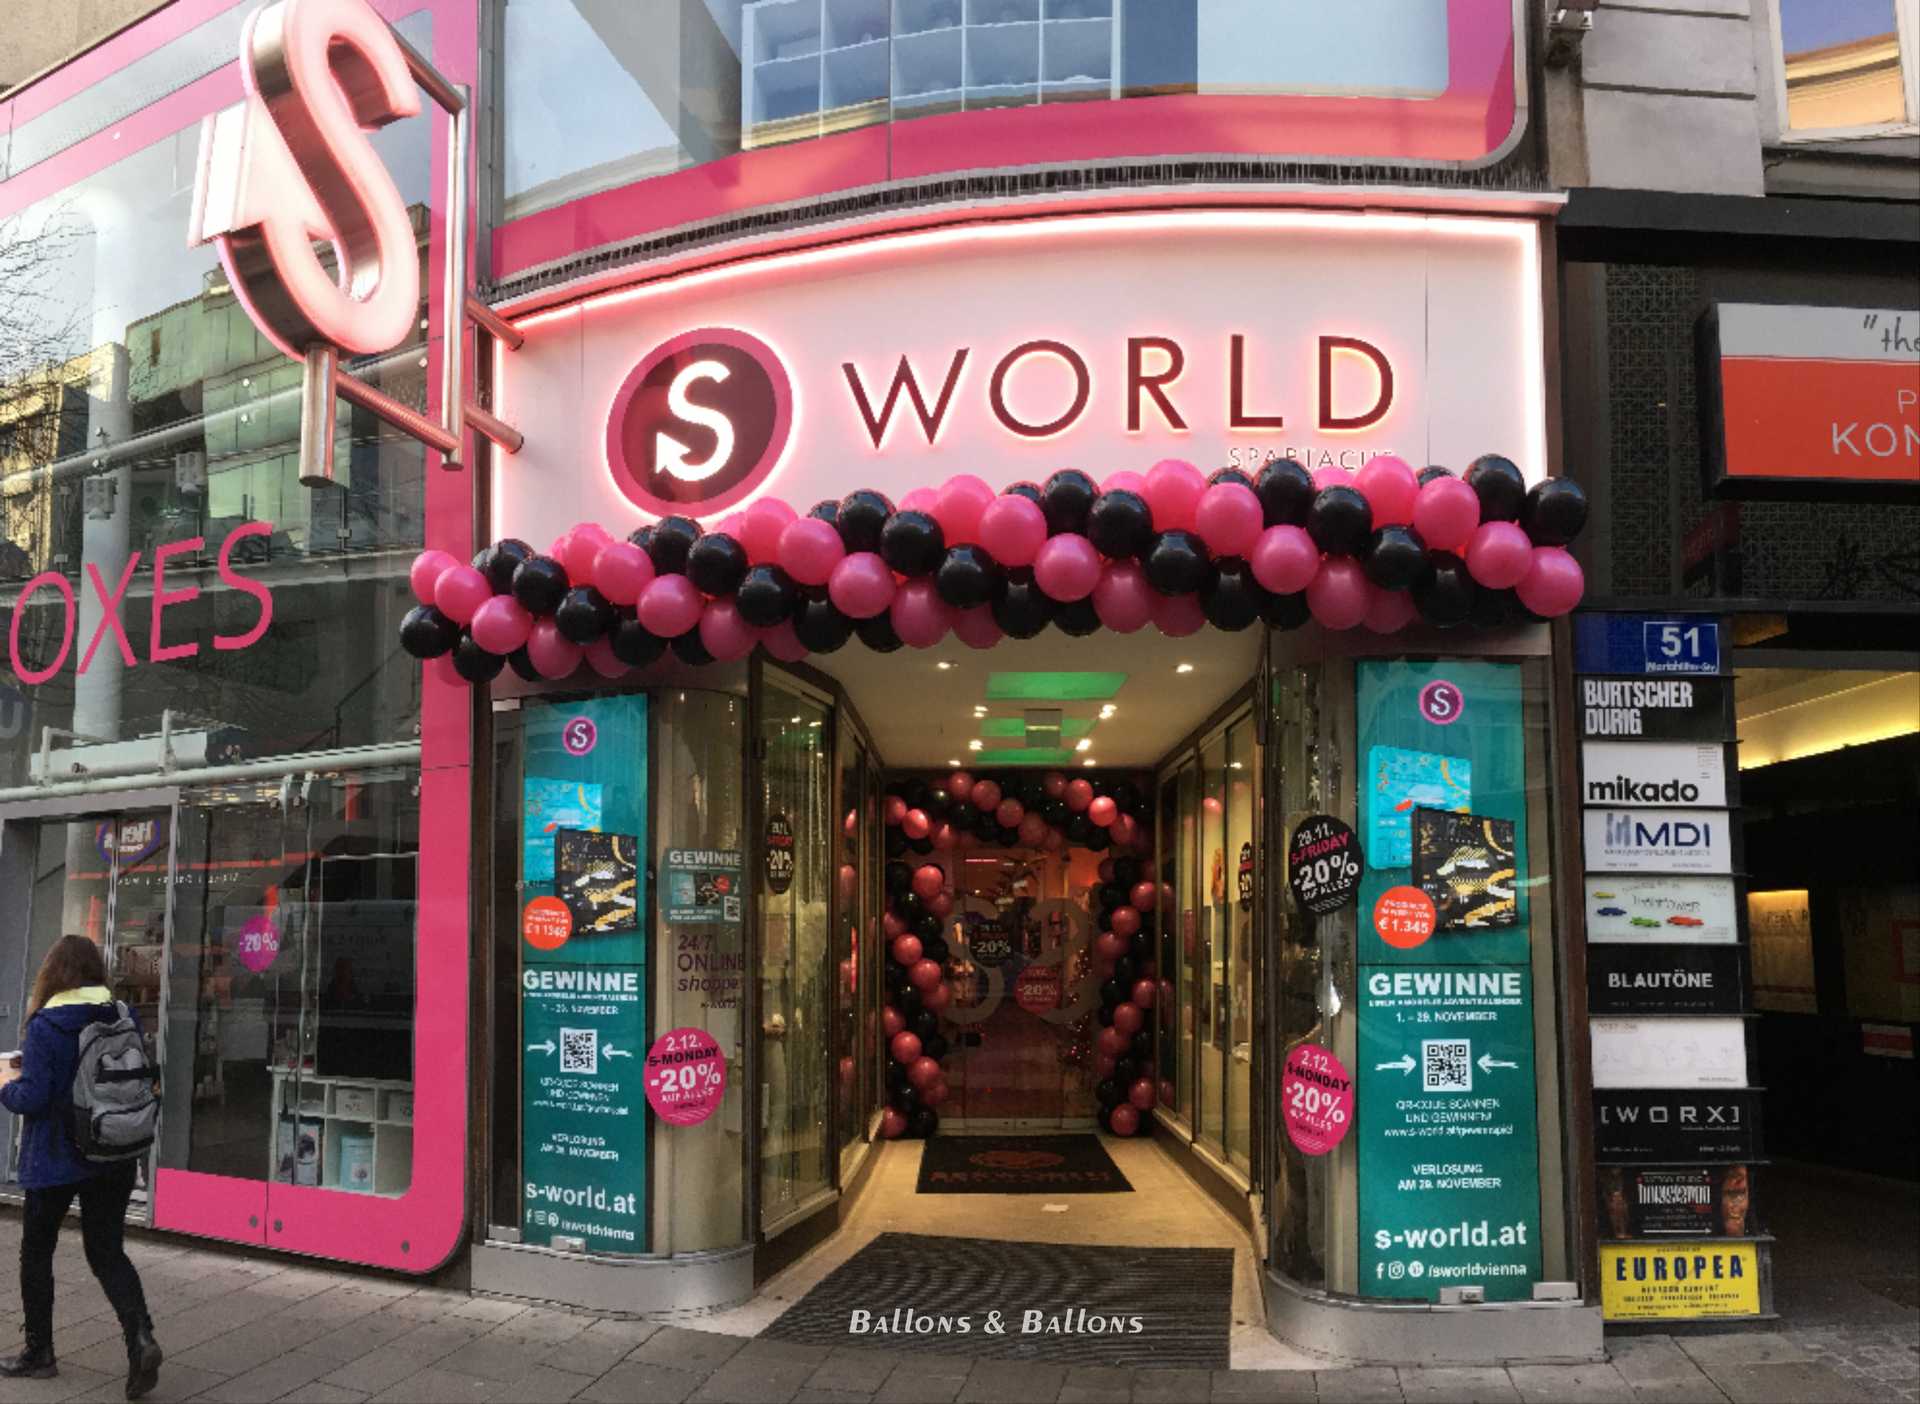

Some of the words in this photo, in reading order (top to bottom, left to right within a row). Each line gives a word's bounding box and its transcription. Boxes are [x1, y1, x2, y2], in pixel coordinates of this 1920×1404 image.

[842, 333, 1395, 450] WORLD
[656, 360, 735, 482] S
[9, 521, 273, 685] OXES
[1660, 626, 1700, 657] 51
[1584, 680, 1693, 708] BURTSCHER
[1585, 708, 1642, 735] DURIG
[1589, 774, 1699, 802] mikado
[1635, 822, 1711, 848] MDI
[669, 850, 742, 867] GEWINNE
[1293, 851, 1359, 891] -20%
[523, 969, 639, 992] GEWINNE
[1369, 973, 1521, 996] GEWINNE
[1608, 969, 1714, 989] BLAUTÖNE
[1434, 1011, 1497, 1023] NOVEMBER
[666, 1034, 702, 1052] 2.12.
[648, 1047, 718, 1067] S-MONDAY
[1301, 1050, 1332, 1073] 2.12.
[650, 1062, 721, 1092] -20%
[1287, 1062, 1350, 1092] S-MONDAY
[1286, 1081, 1345, 1124] -20%
[1398, 1179, 1416, 1191] AM
[1437, 1177, 1501, 1190] NOVEMBER
[526, 1182, 636, 1216] s-world.at
[1374, 1220, 1527, 1250] s-world.at
[1616, 1255, 1743, 1282] EUROPEA
